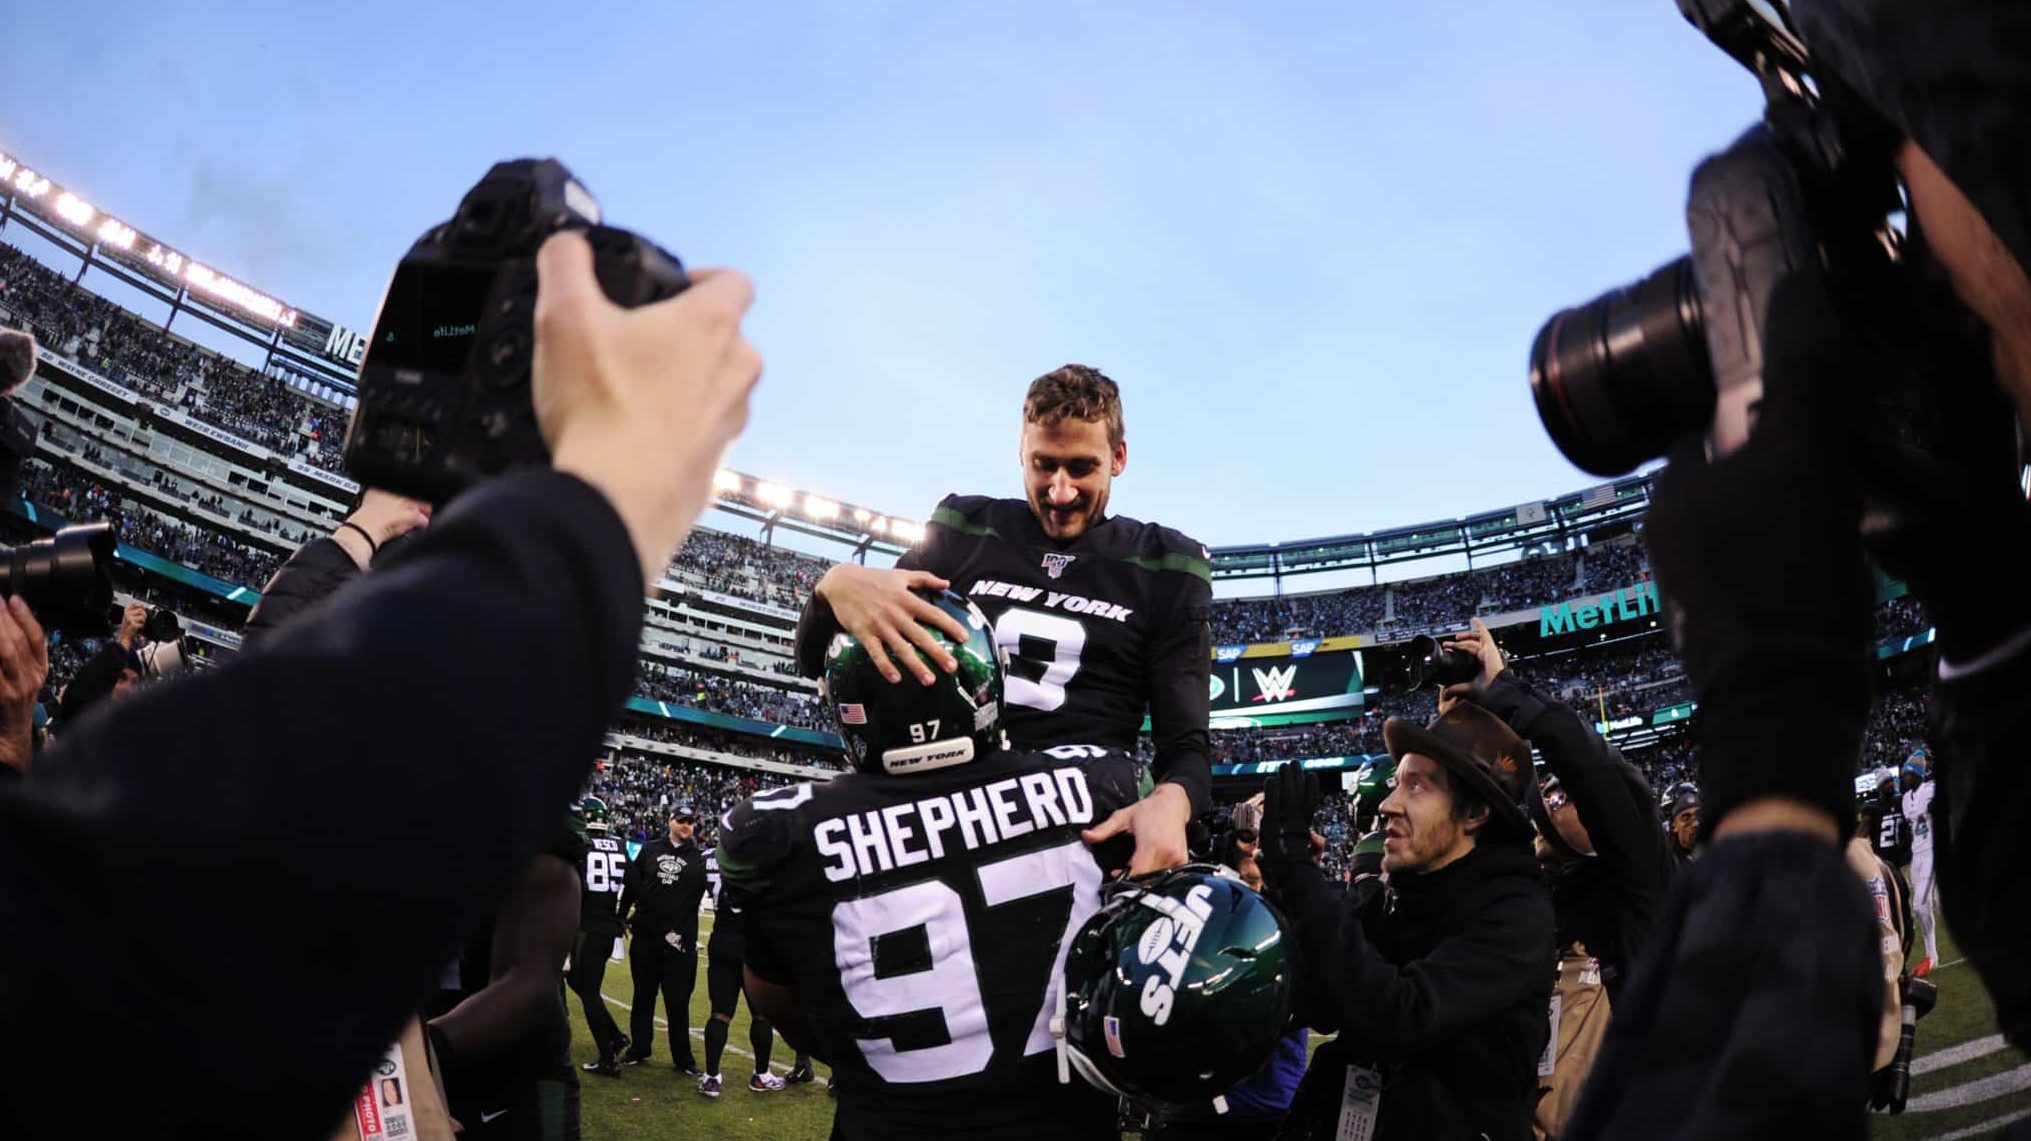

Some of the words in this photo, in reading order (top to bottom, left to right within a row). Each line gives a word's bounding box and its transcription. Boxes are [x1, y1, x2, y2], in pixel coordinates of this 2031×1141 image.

[969, 580, 1043, 602] NEW
[1044, 592, 1134, 622] YORK
[995, 608, 1087, 711] 9
[1217, 649, 1241, 660] SAP
[1292, 642, 1316, 654] SAP
[910, 719, 940, 743] 97
[890, 756, 923, 767] NEW
[927, 749, 965, 761] YORK
[814, 768, 1093, 883] SHEPHERD
[586, 851, 626, 892] 85
[833, 841, 1103, 1084] 97
[1138, 884, 1213, 1027] JETS
[362, 1095, 377, 1133] PHOTO
